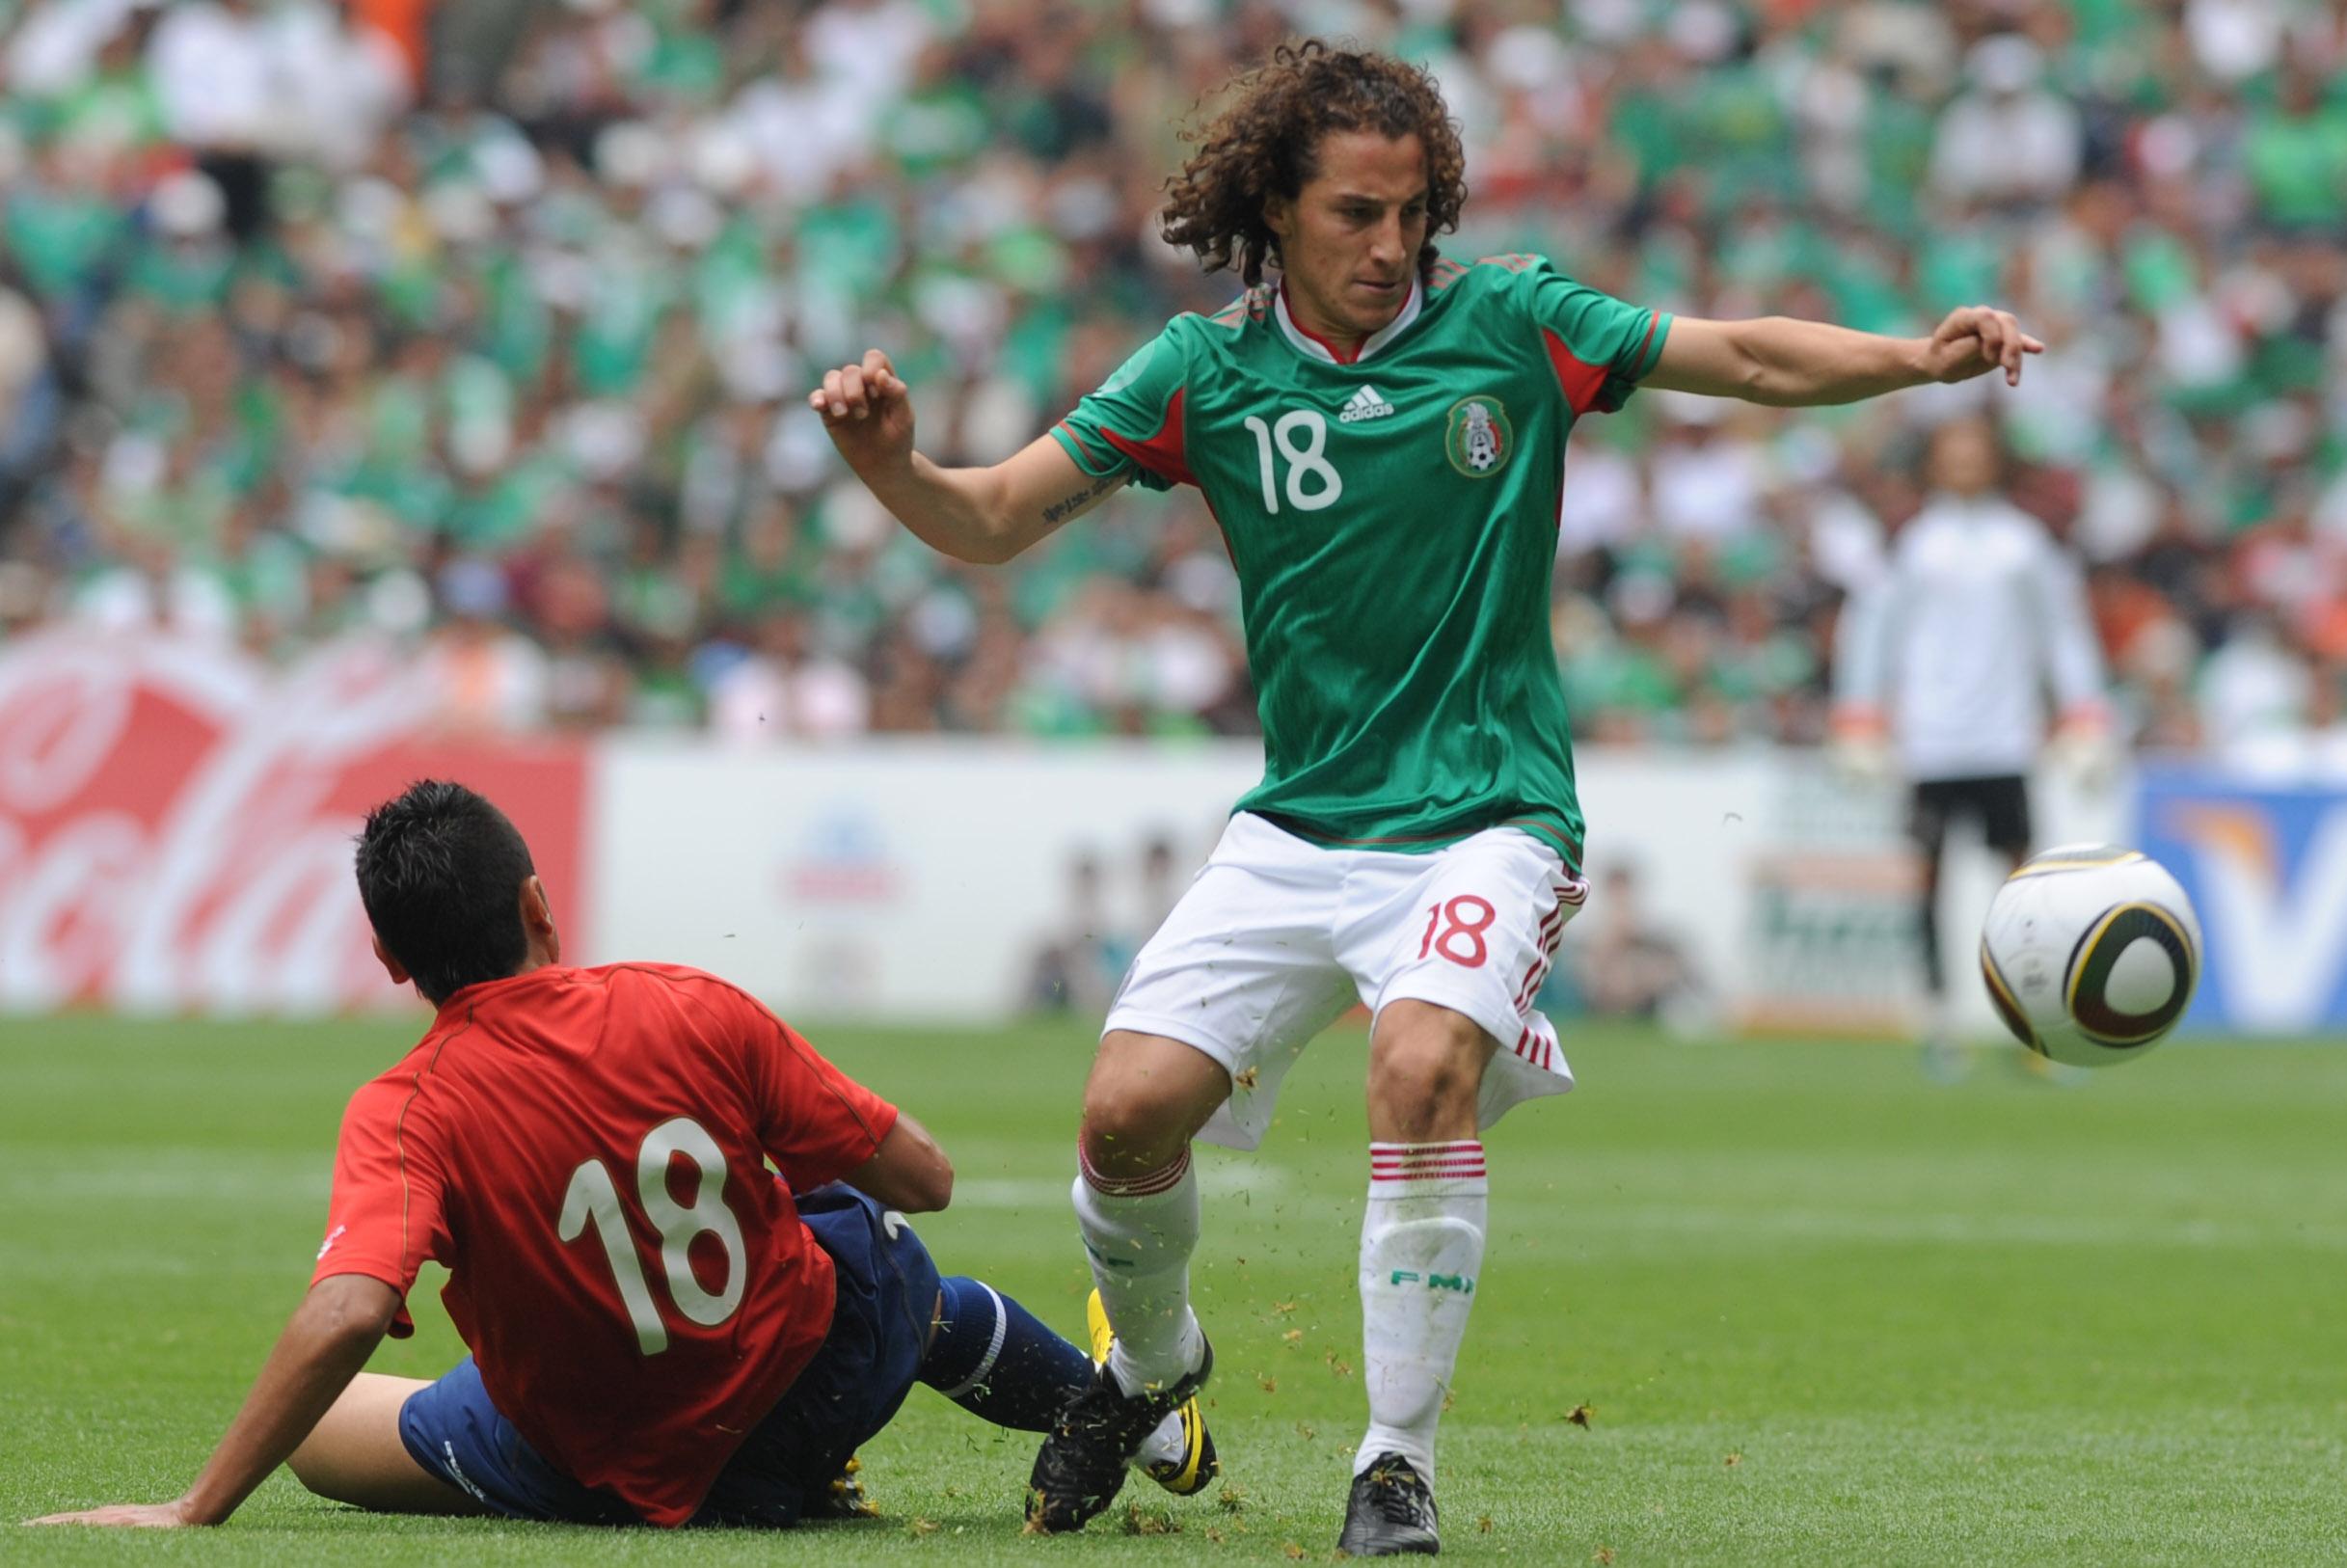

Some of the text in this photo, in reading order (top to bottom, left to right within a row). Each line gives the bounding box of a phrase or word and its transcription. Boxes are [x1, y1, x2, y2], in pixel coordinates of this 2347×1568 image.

[1339, 403, 1394, 423] adidas
[1244, 409, 1343, 515] 18
[1417, 894, 1497, 968] 18
[558, 1115, 748, 1356] 18
